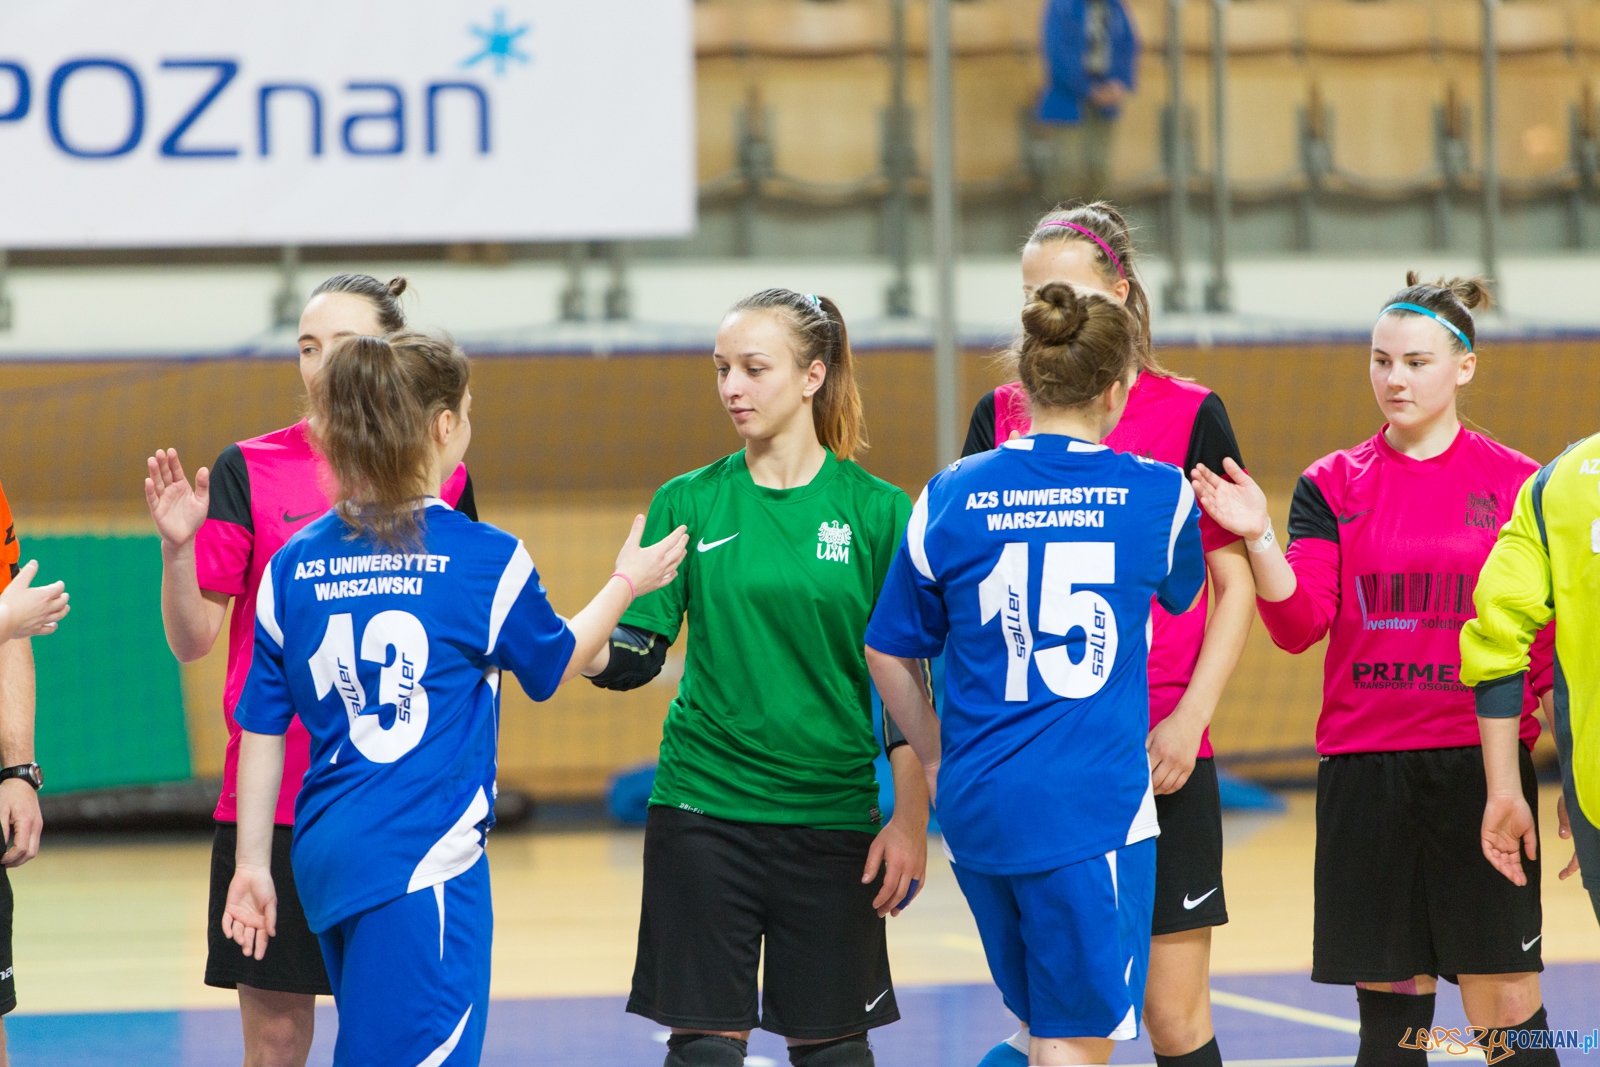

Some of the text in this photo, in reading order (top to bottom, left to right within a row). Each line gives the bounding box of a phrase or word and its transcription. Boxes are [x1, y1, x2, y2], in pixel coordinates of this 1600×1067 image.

[1579, 458, 1600, 475] AZ
[965, 487, 1129, 510] AZS UNIWERSYTET
[986, 510, 1105, 531] WARSZAWSKI
[294, 553, 450, 580] AZS UNIWERSYTET
[314, 577, 423, 601] WARSZAWSKI
[978, 541, 1118, 702] 15
[1006, 585, 1026, 660] saller
[1421, 615, 1466, 630] solutio
[1091, 602, 1107, 678] saller
[1352, 662, 1462, 684] PRIME
[308, 609, 430, 764] 13
[336, 656, 362, 719] aller
[398, 652, 415, 724] saller
[1354, 681, 1475, 694] TRANSPORT OSOBOW
